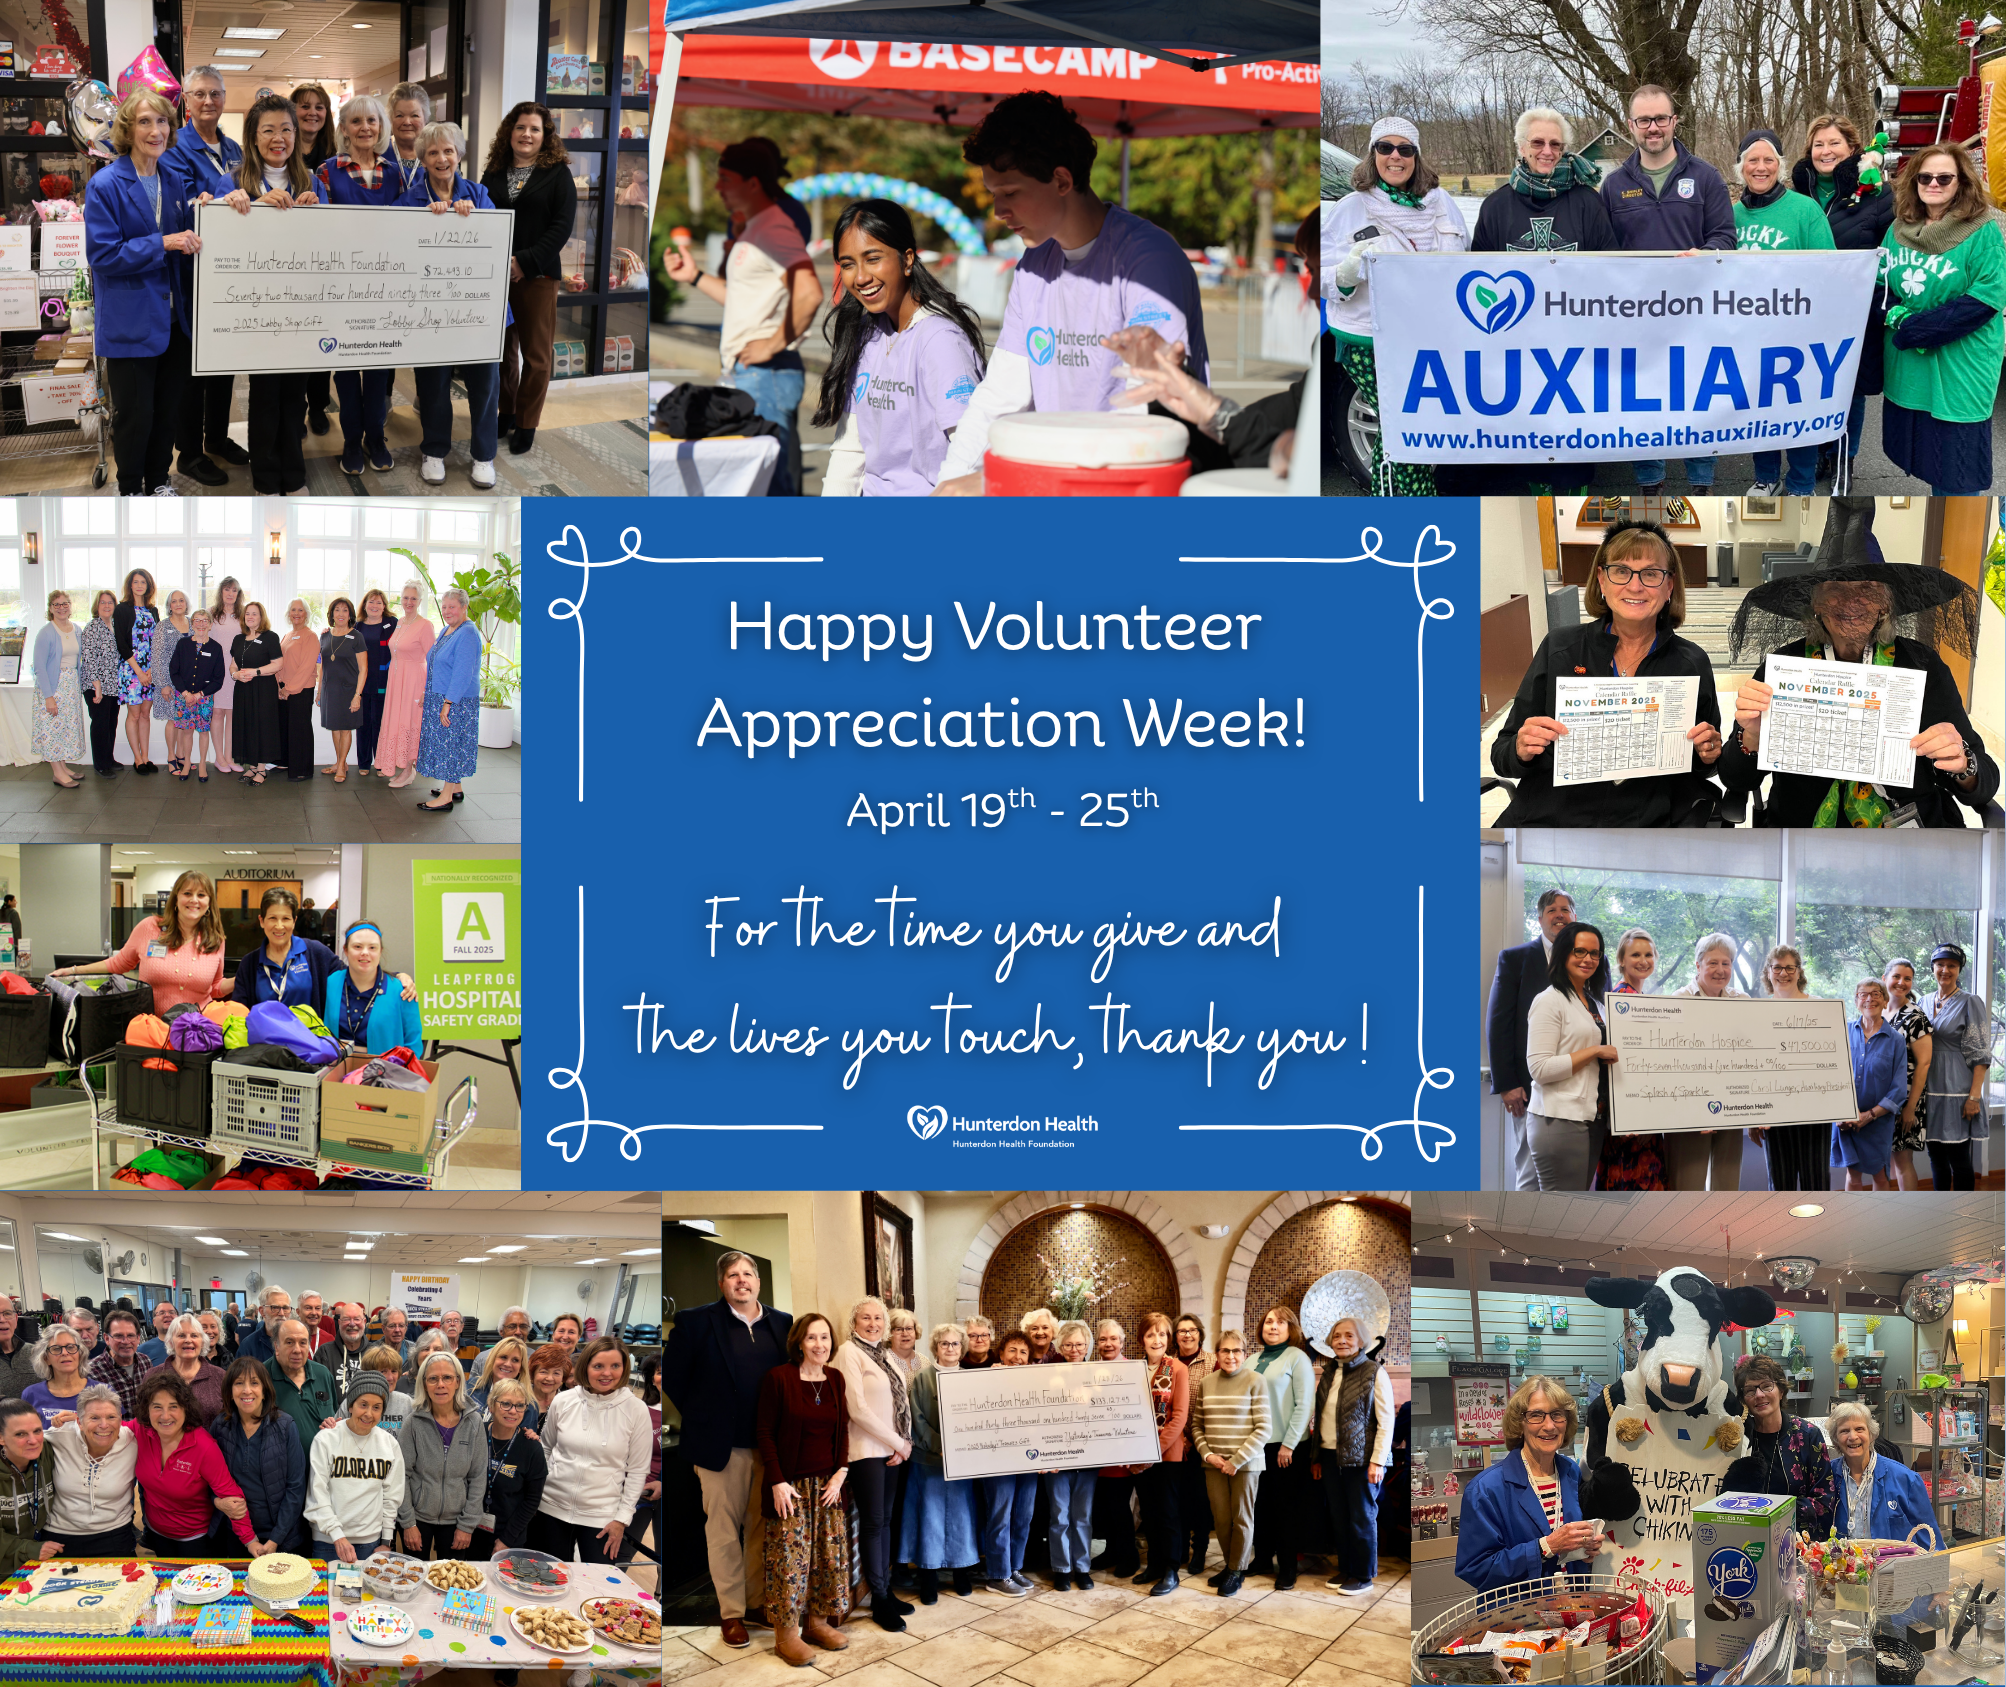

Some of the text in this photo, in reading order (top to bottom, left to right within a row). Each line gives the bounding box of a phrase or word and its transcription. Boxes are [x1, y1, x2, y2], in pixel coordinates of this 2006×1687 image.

[889, 41, 1158, 80] BASECAMP
[1980, 82, 1994, 132] KEEP
[434, 231, 479, 246] 1/22/26
[1736, 224, 1790, 249] UCKY
[247, 250, 405, 272] Hunterdon Health Foundation
[225, 286, 261, 307] Seventy
[265, 287, 282, 301] two
[284, 284, 324, 301] thousand
[328, 285, 346, 301] four
[348, 283, 384, 300] hundred
[388, 284, 416, 308] ninety
[420, 284, 442, 299] three
[1544, 288, 1812, 318] Hunterdon Health
[338, 340, 402, 350] Hunterdon Health
[1056, 329, 1106, 346] Hunterdo
[1402, 337, 1856, 416] AUXILIARY
[1401, 410, 1846, 450] www.hunterdonhealthauxiliary.org
[1779, 682, 1877, 699] NOVEMBER 2025
[1565, 698, 1628, 707] NOVEMBER
[224, 868, 295, 879] AUDITORIUM
[456, 902, 491, 941] A
[453, 946, 494, 954] FALL 2025
[434, 973, 516, 986] LEAPFROG
[423, 991, 521, 1009] HOSPITAL
[424, 1014, 474, 1026] SAFETY
[1786, 1014, 1818, 1030] 6/17/25
[1650, 1028, 1754, 1052] Hunterdon Hospice
[1731, 1059, 1759, 1070] hundred
[1640, 1085, 1668, 1102] Splash
[1678, 1086, 1710, 1100] Sparkle
[349, 1140, 377, 1149] BANKERS
[422, 1276, 450, 1284] BIRTHDAY
[1452, 1365, 1477, 1373] FLAGS
[969, 1394, 1013, 1410] Hunterdon
[1014, 1390, 1040, 1406] Health
[1043, 1388, 1085, 1404] Foundation
[1459, 1406, 1505, 1421] wildflower
[330, 1456, 392, 1480] COLORADO
[1621, 1464, 1724, 1496] ELUBRATE
[1646, 1494, 1692, 1516] WITH
[1633, 1516, 1692, 1542] CHIKIN
[177, 1578, 222, 1588] BIRTHDAY
[185, 1574, 226, 1583] HAPPY
[1708, 1557, 1753, 1598] York
[452, 1594, 481, 1607] BIRTH
[453, 1590, 481, 1600] HAPPY
[453, 1601, 475, 1611] DAY
[353, 1624, 408, 1634] BIRTHDAY
[358, 1616, 401, 1626] HAPPY
